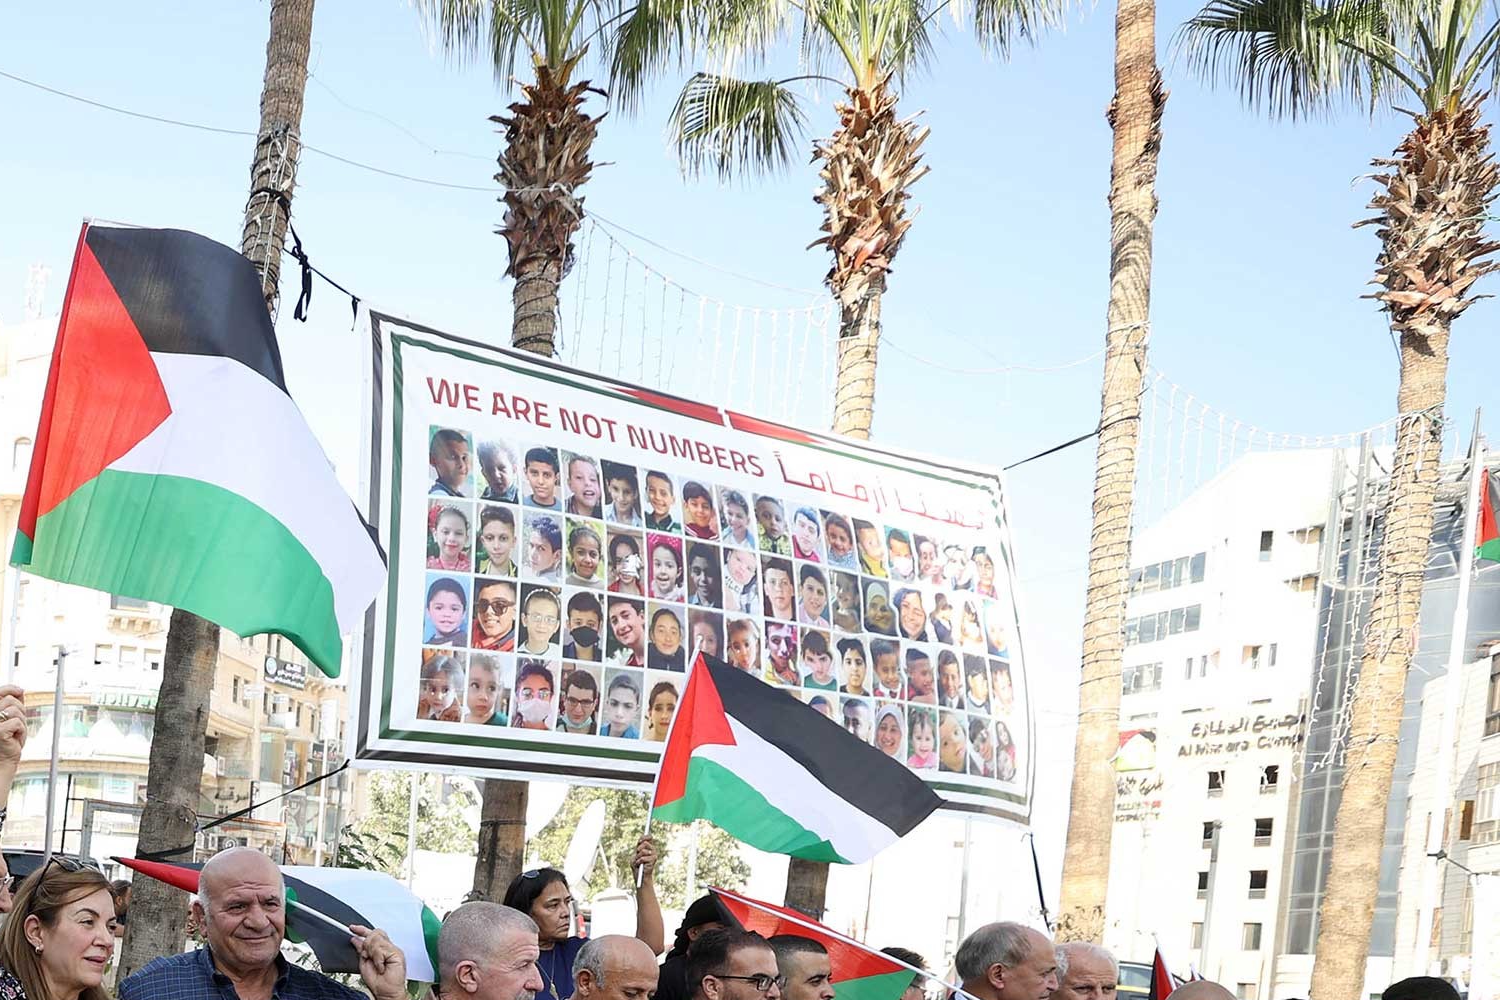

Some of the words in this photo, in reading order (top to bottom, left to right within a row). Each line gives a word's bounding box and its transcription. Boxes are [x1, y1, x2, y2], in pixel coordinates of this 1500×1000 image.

[426, 376, 483, 412] WE
[491, 391, 552, 429] ARE
[558, 407, 618, 443] NOT
[627, 424, 765, 478] NUMBERS
